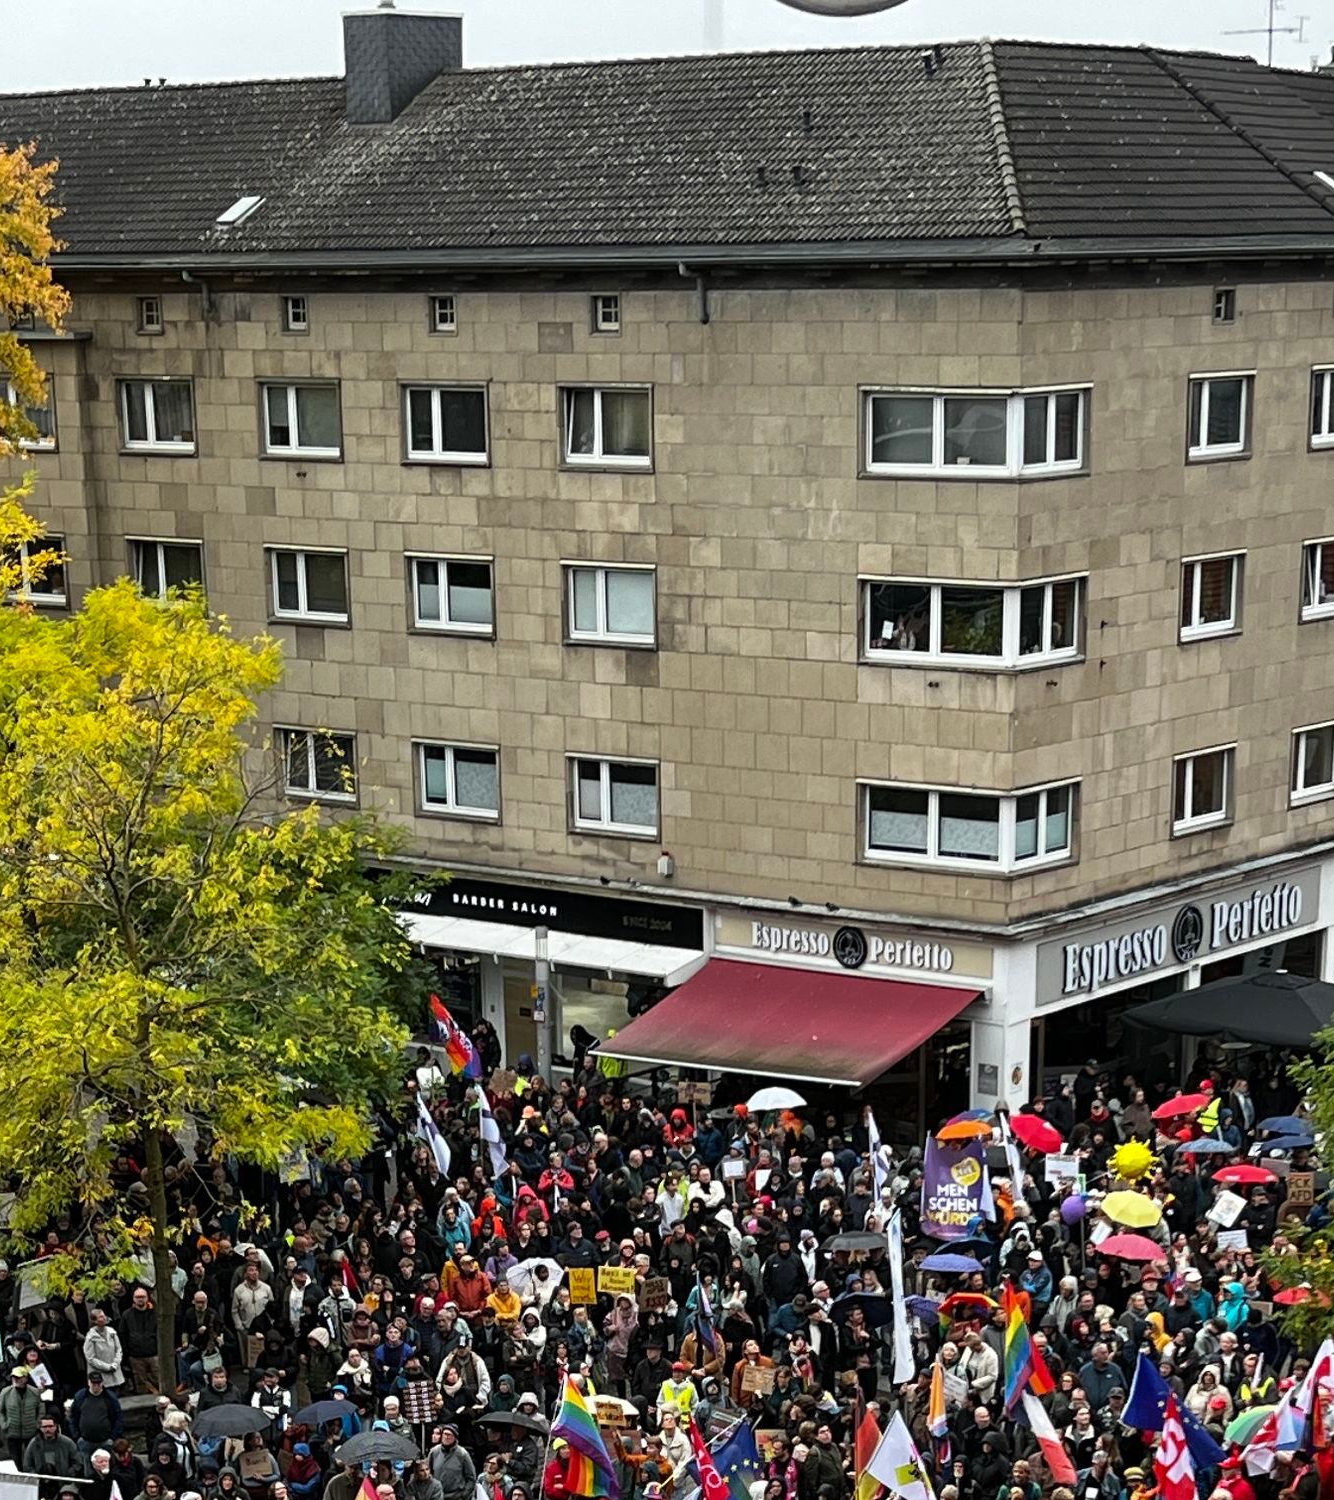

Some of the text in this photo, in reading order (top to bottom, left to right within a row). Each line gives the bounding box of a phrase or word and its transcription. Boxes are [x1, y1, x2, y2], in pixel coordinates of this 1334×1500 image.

[452, 893, 505, 909] BARBER
[512, 897, 558, 916] SALON
[751, 921, 954, 971] Espresso Perfetto
[1063, 882, 1302, 995] Espresso Perfetto
[937, 1184, 969, 1197] MEN
[1291, 1190, 1312, 1201] AFD
[928, 1197, 977, 1212] SCHEN
